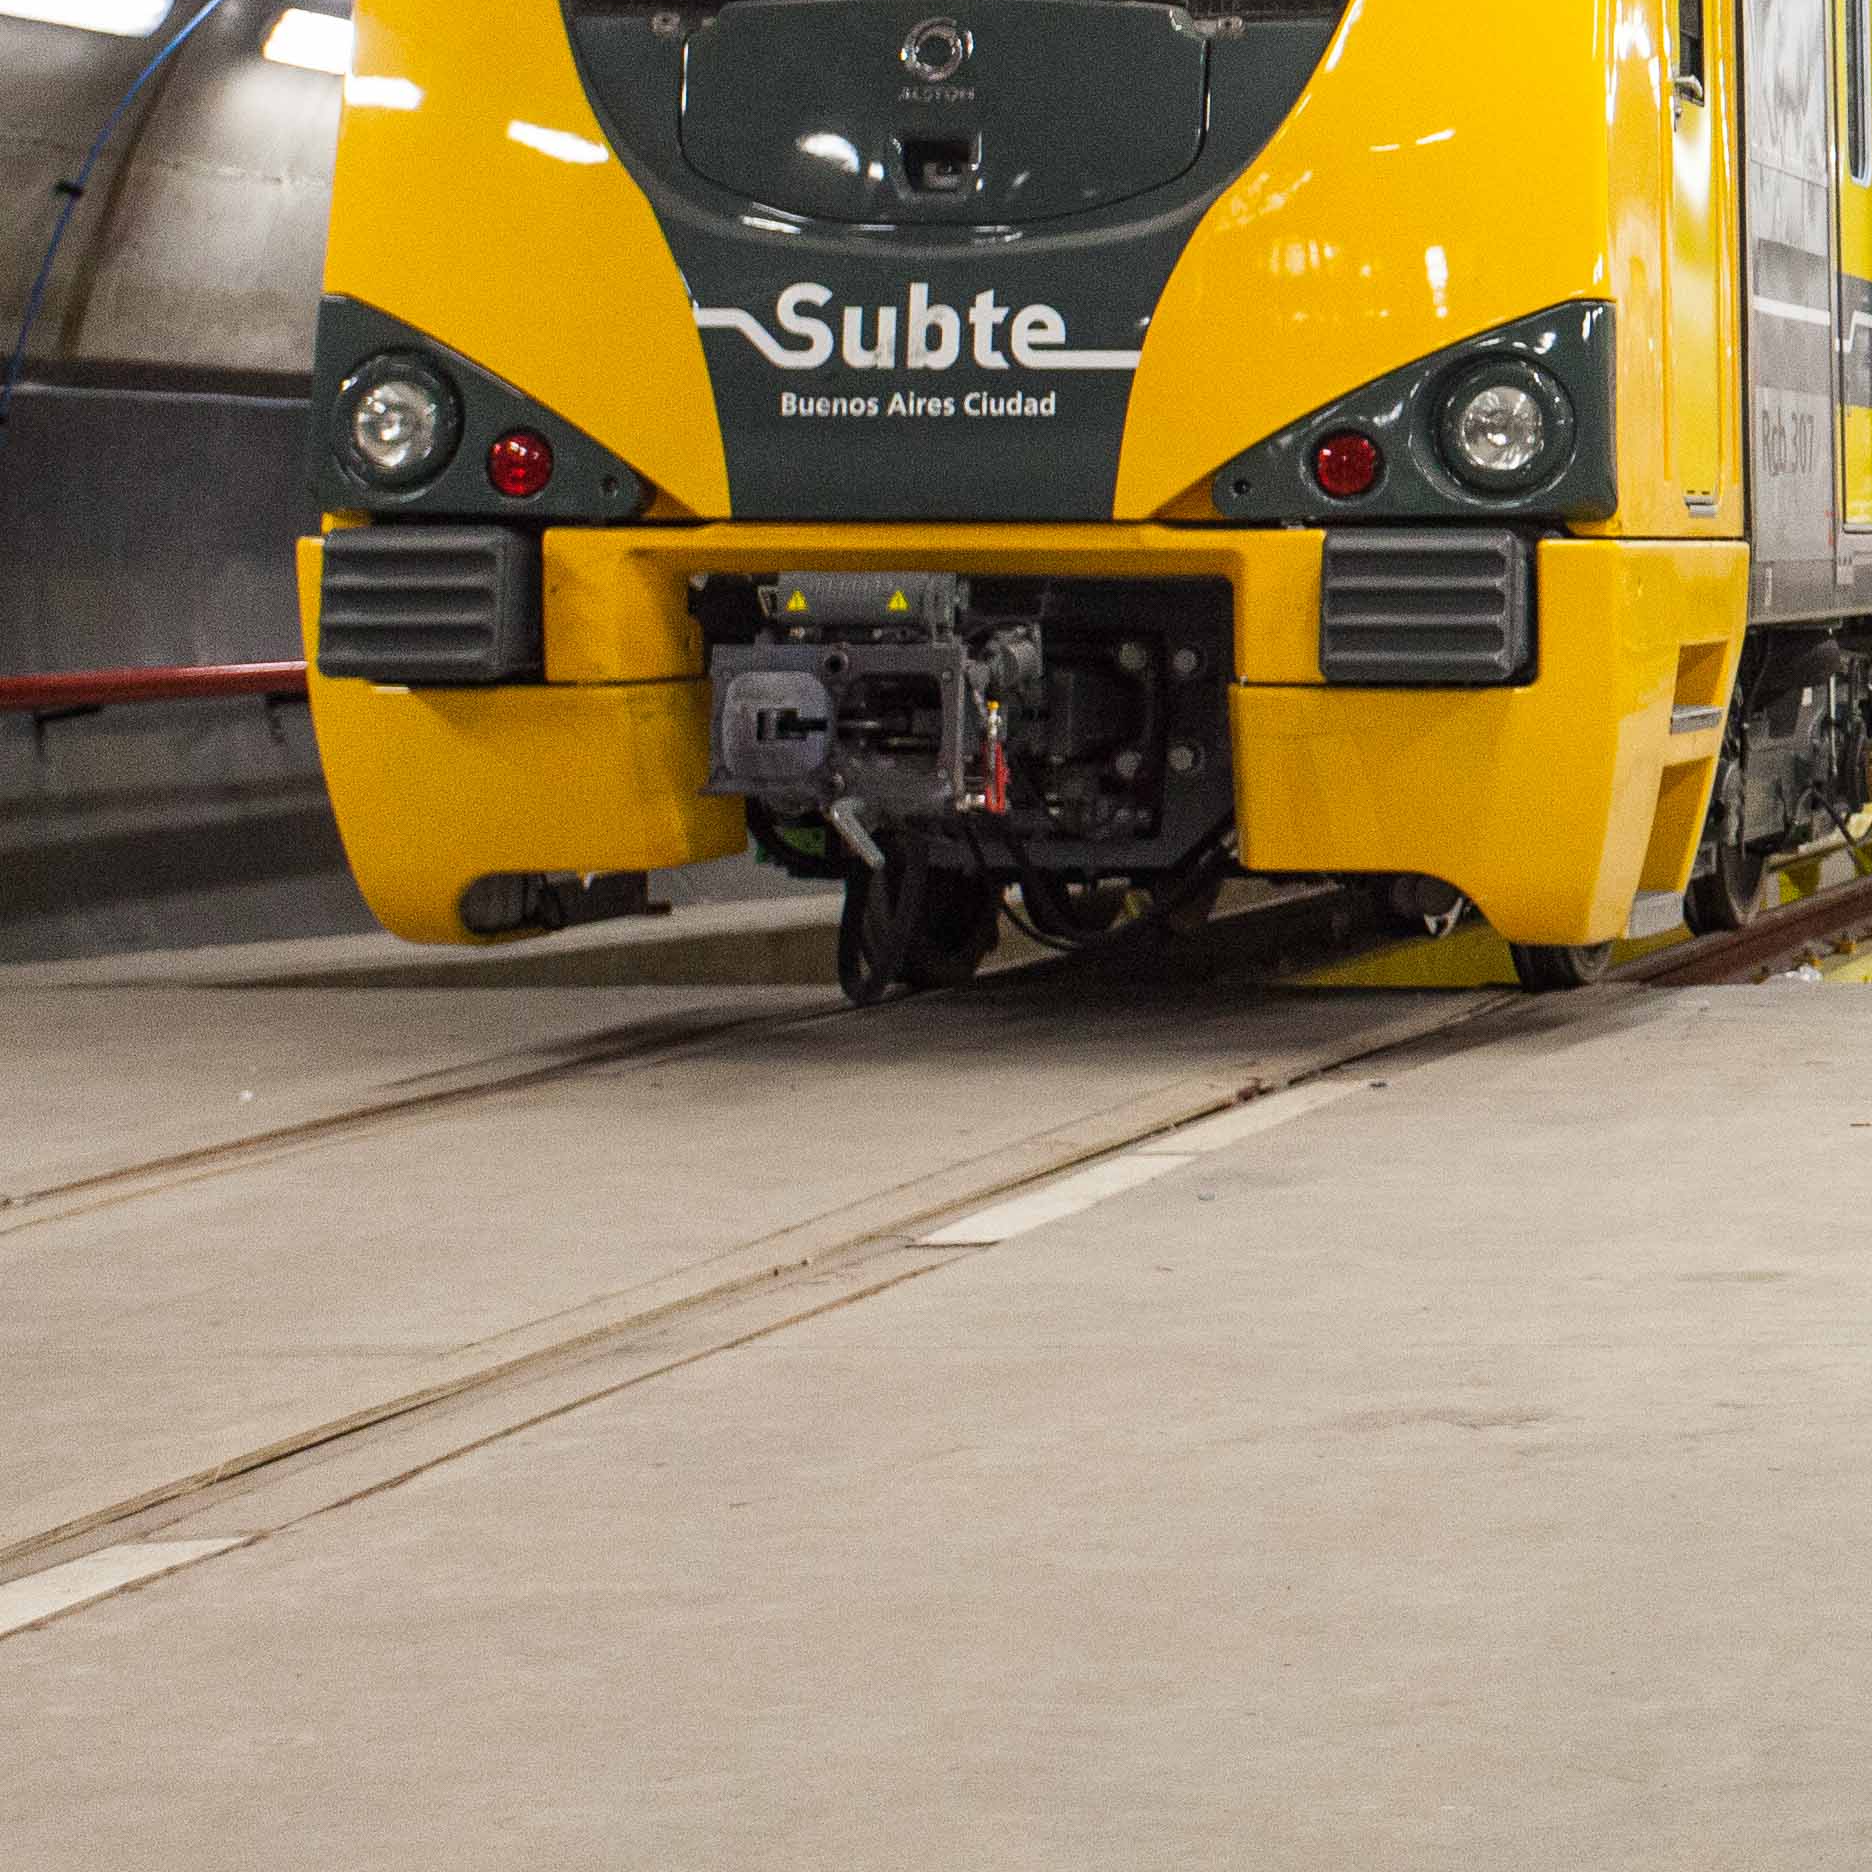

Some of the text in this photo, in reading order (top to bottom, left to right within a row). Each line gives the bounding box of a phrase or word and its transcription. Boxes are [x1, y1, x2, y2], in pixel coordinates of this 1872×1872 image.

[771, 281, 1069, 371] Subte
[780, 390, 1057, 418] Buenos Aires Ciudad
